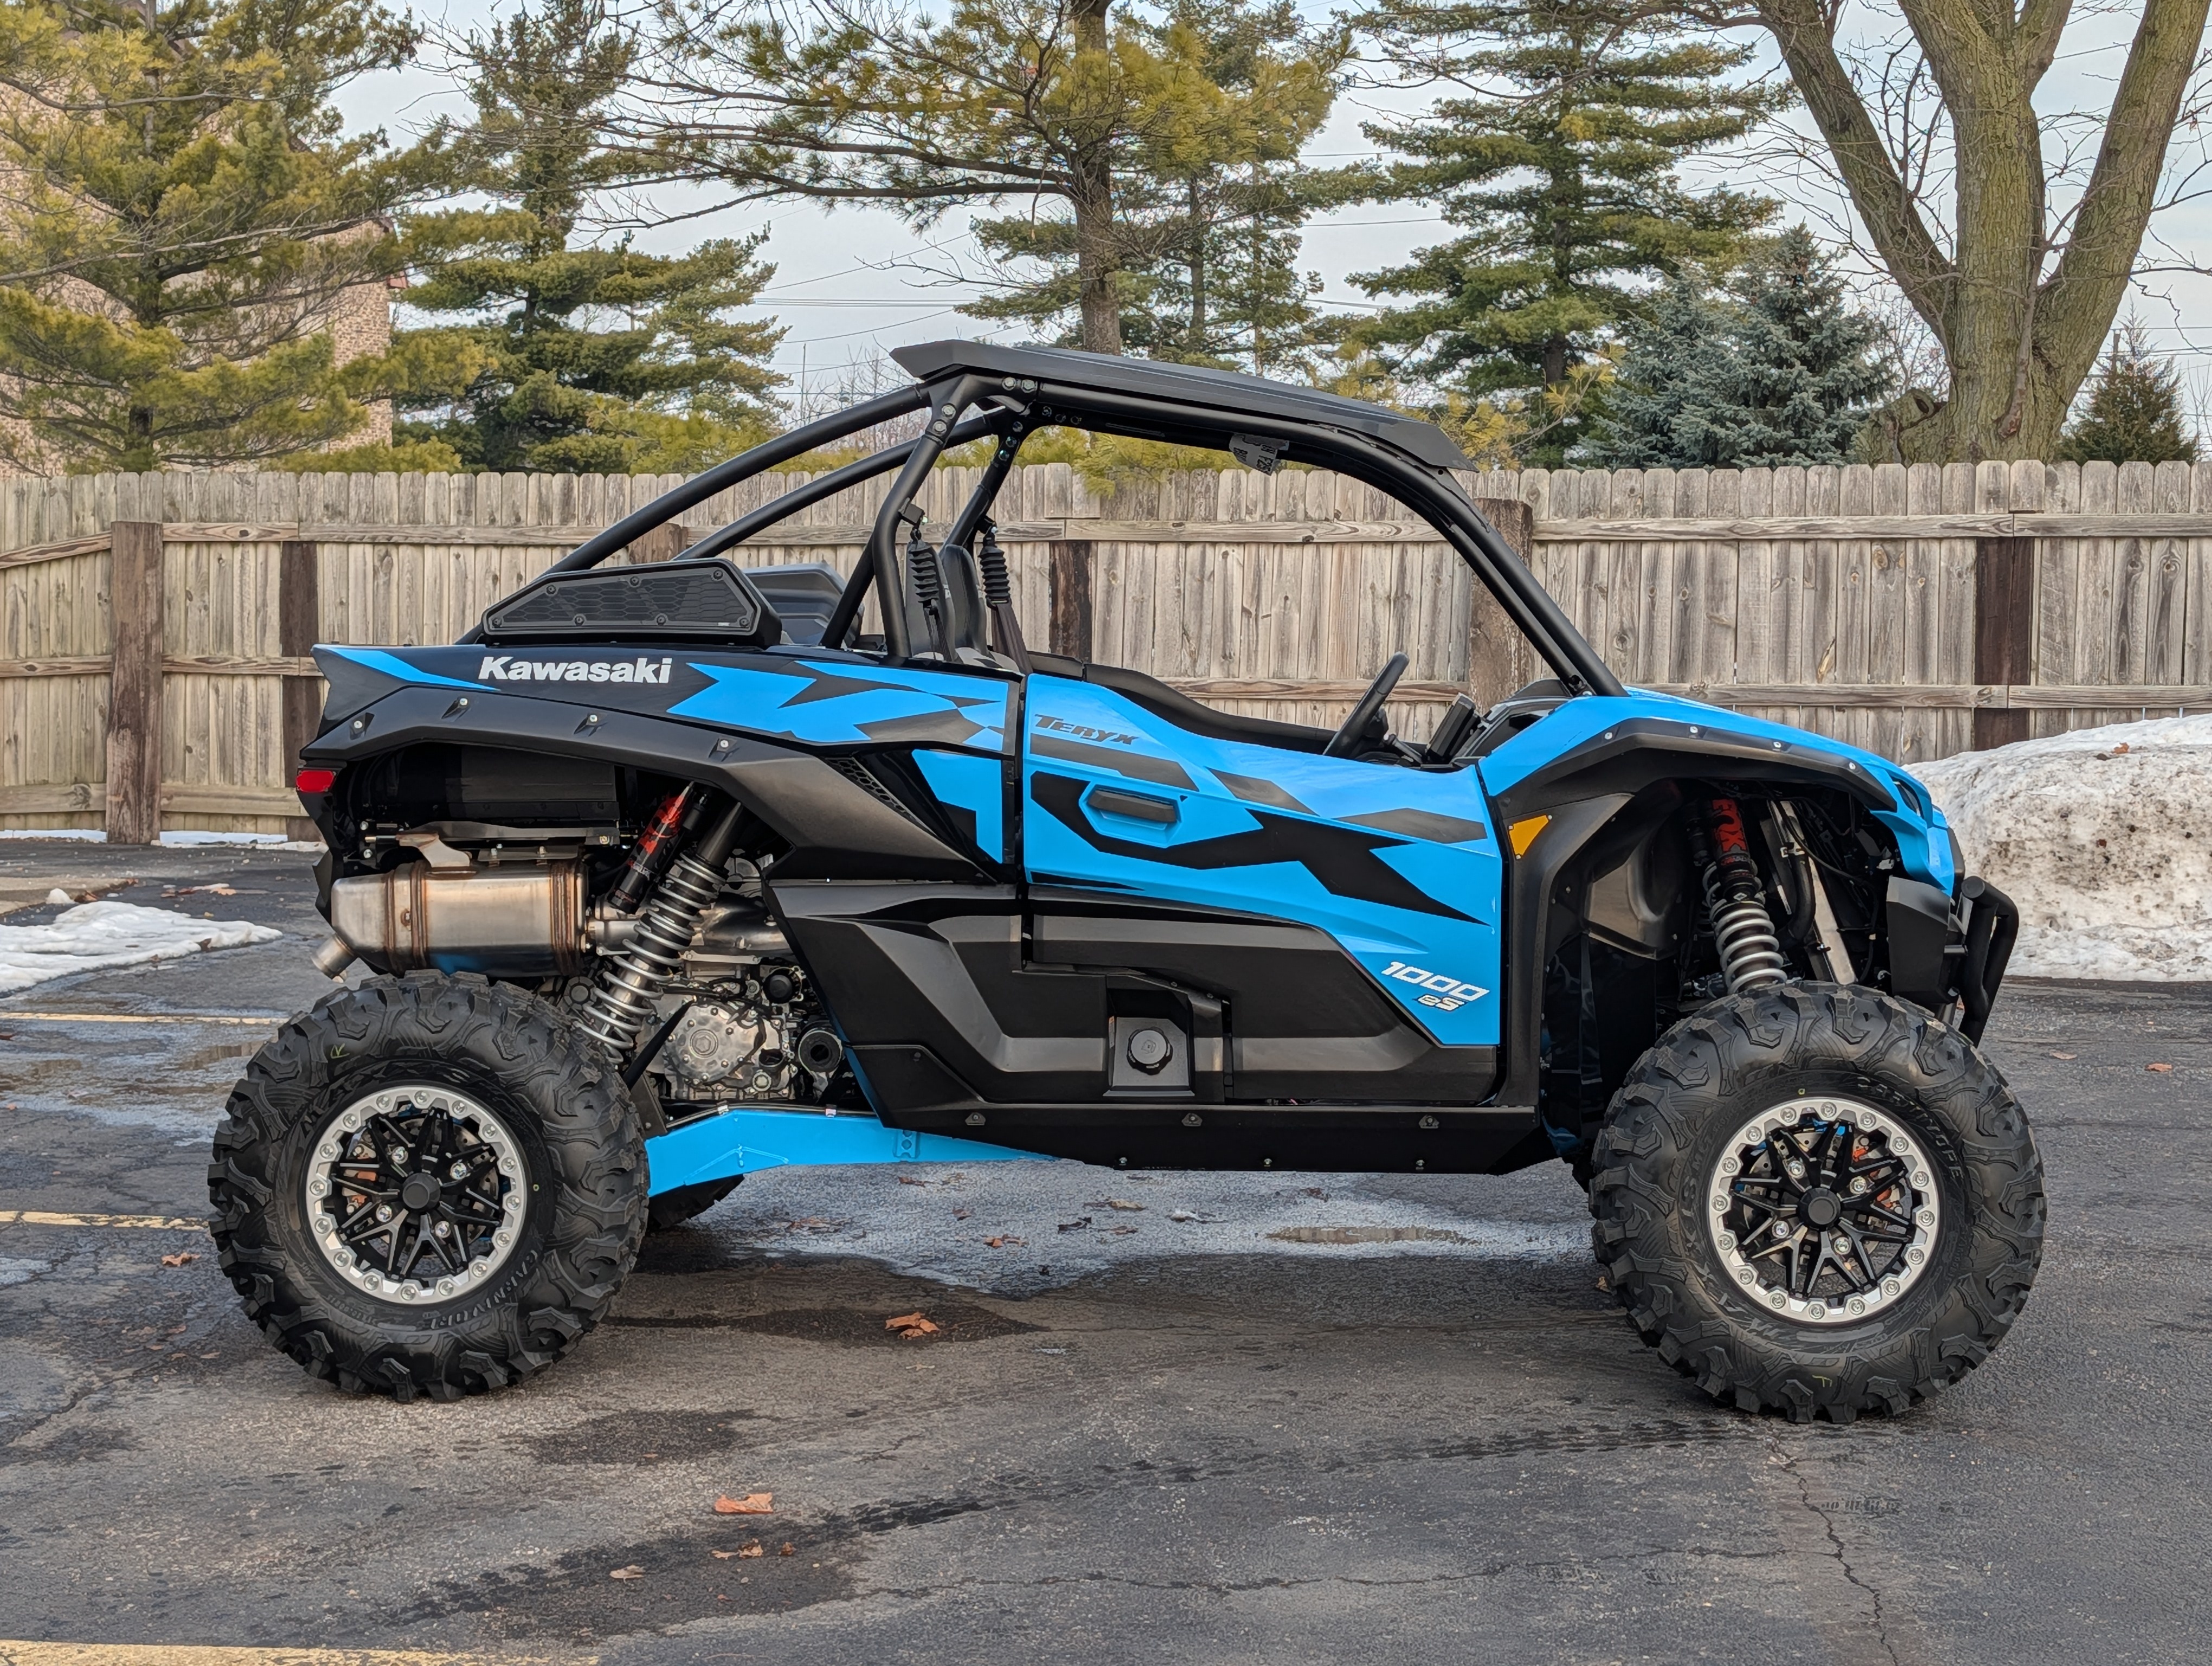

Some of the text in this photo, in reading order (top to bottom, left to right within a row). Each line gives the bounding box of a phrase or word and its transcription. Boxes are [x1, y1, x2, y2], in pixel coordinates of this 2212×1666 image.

[478, 656, 672, 683] Kawasaki
[1034, 714, 1139, 745] TERYX
[1712, 799, 1746, 851] FOX
[1381, 962, 1490, 1001] 1000
[426, 1249, 538, 1330] CARNIVORE
